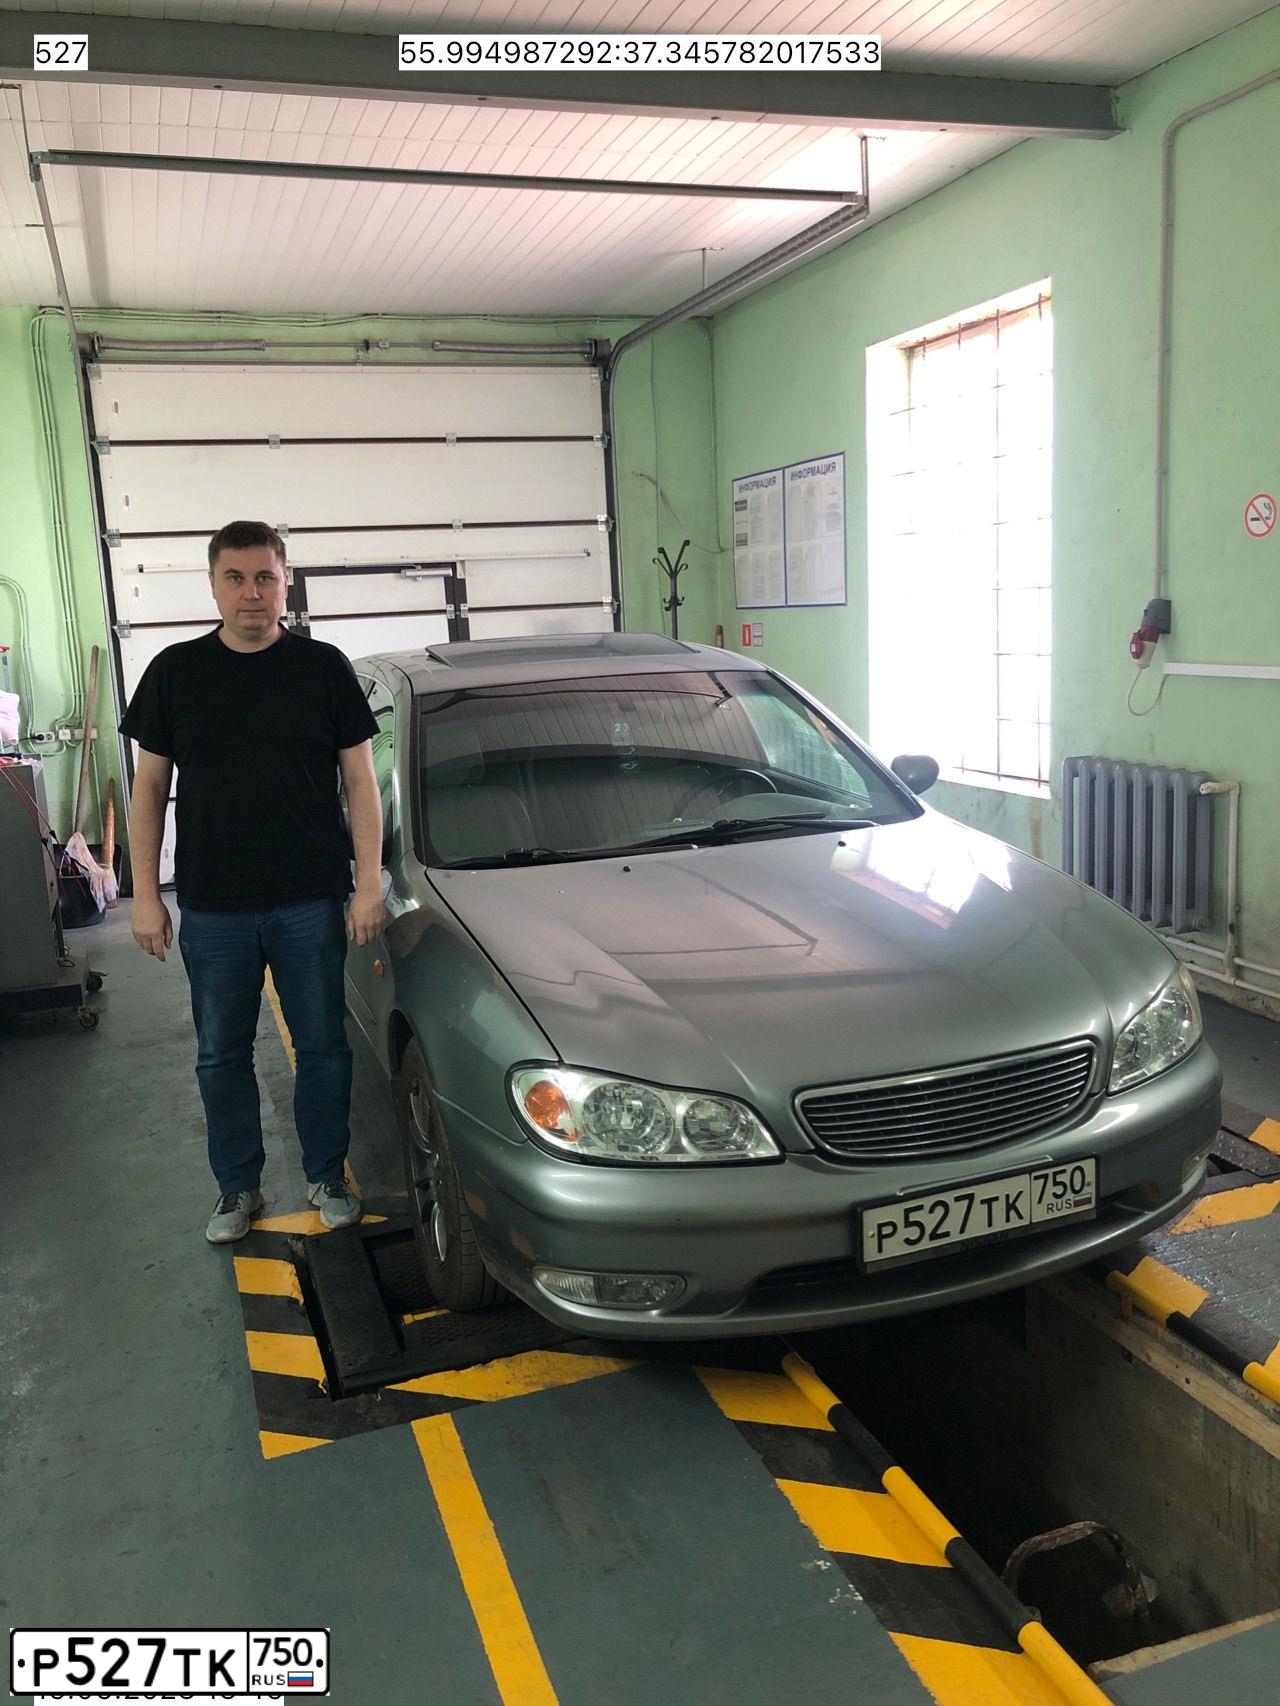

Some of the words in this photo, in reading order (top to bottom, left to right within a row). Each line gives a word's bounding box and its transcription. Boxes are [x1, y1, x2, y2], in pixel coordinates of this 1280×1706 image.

[790, 462, 836, 482] ИНФОРМАЦИЯ
[1033, 1165, 1086, 1205] 750
[1046, 1199, 1073, 1214] RUS
